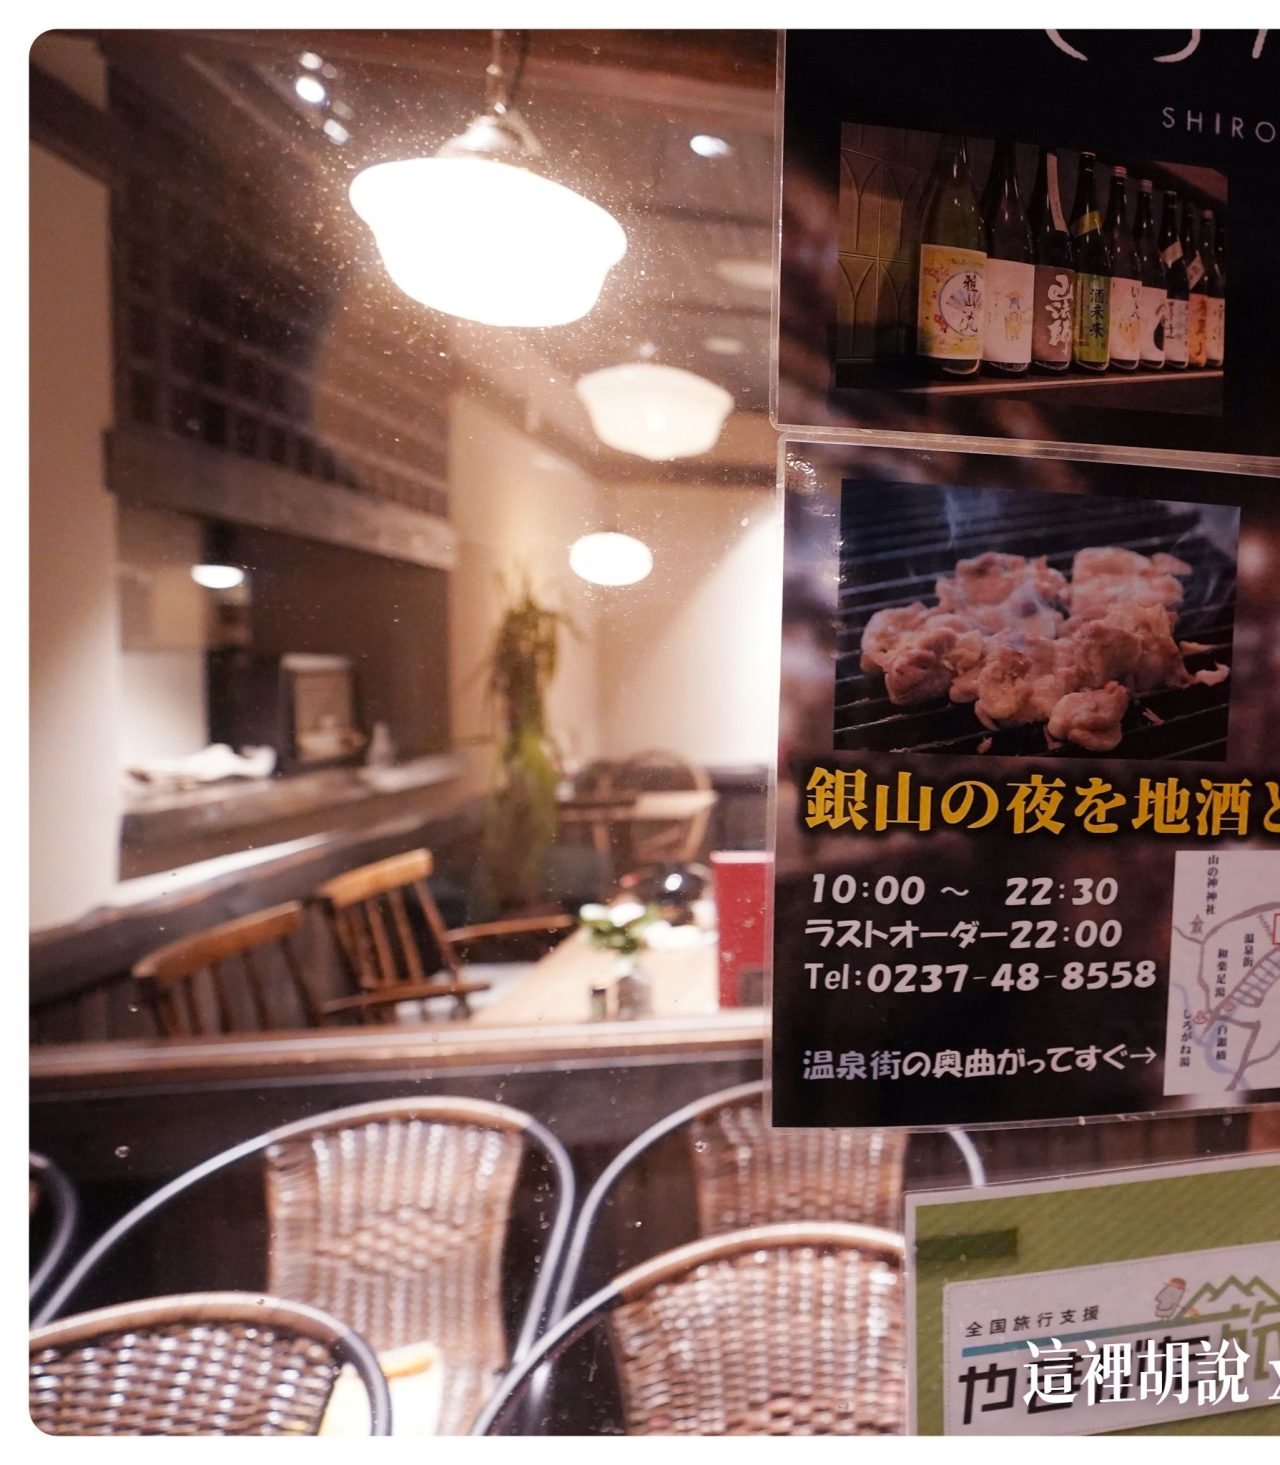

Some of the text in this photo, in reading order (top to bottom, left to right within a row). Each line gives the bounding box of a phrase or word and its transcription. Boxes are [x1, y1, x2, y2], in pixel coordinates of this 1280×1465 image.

[1089, 287, 1105, 339] 酒未来
[812, 873, 926, 905] 10:00
[1005, 877, 1119, 906] 22:30
[804, 919, 1123, 949] ラストオーダー22:00
[1242, 933, 1255, 968] 温泉街
[804, 960, 1157, 993] Tel:0237-48-8558
[803, 1044, 1127, 1081] 温泉街の奥曲がってすぐ
[965, 1305, 1101, 1338] 全国旅行支援
